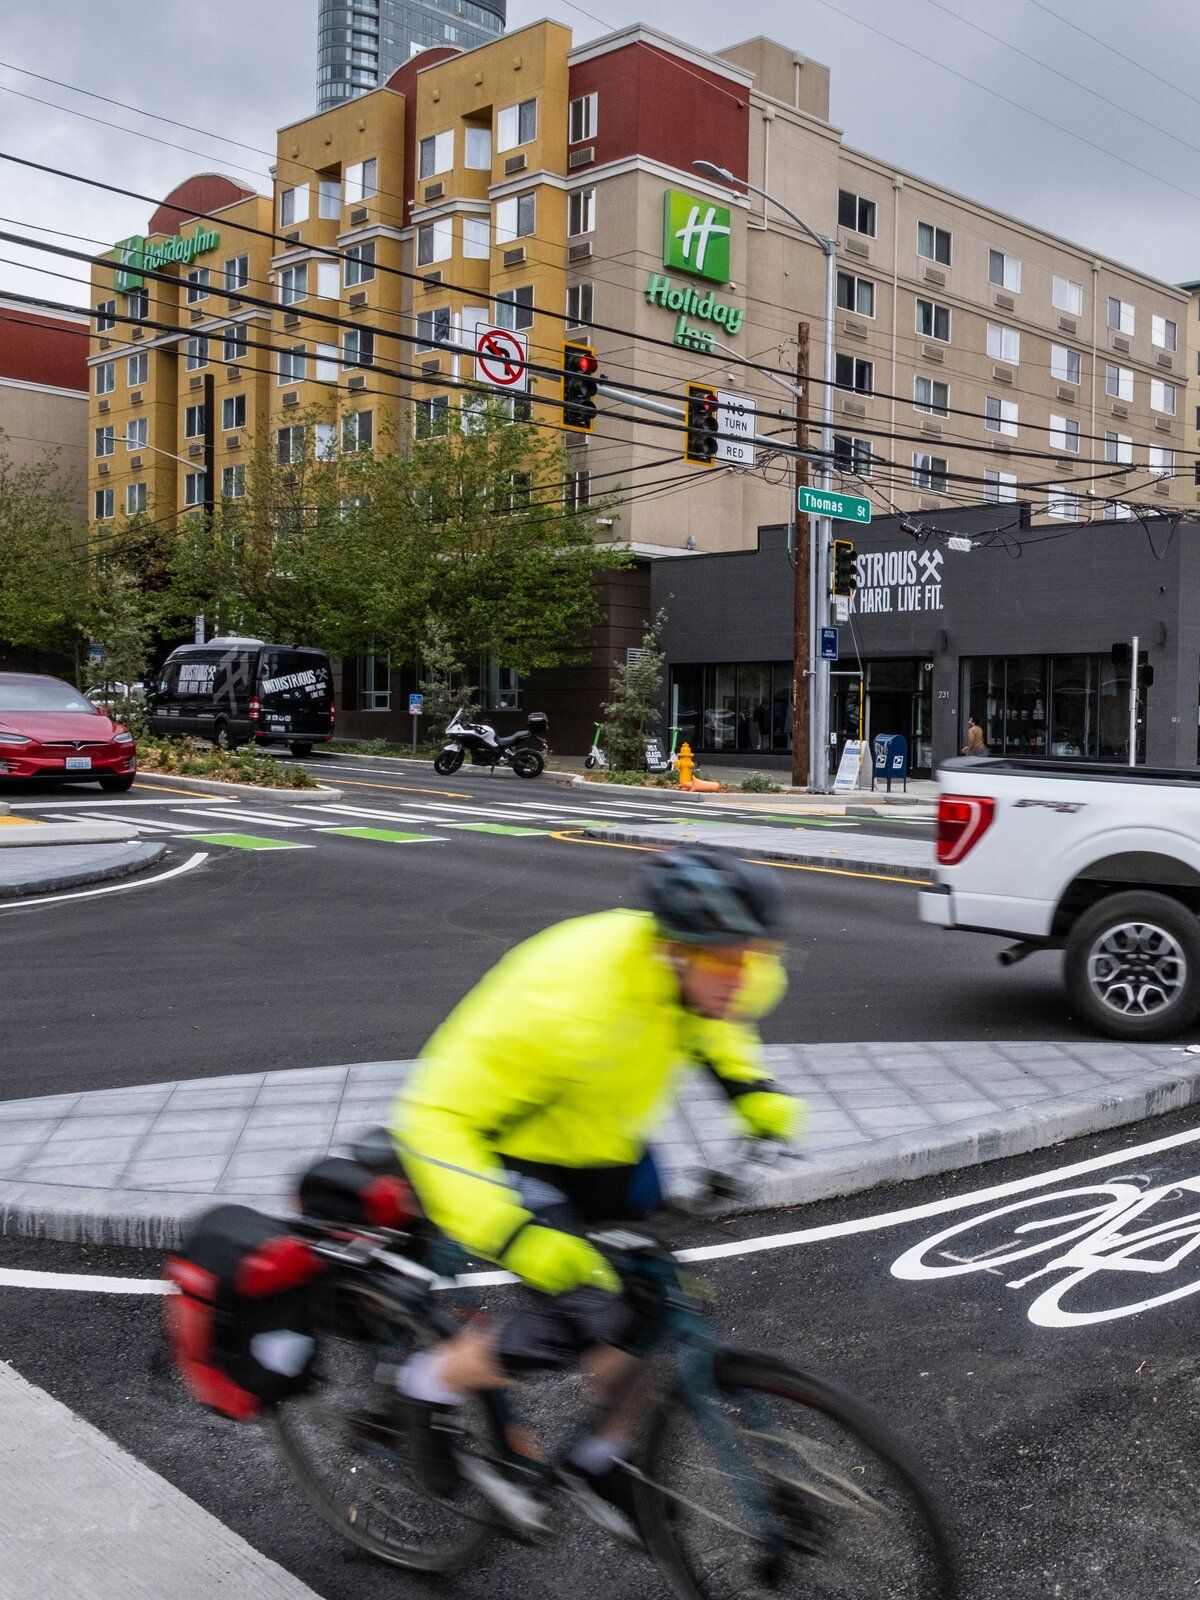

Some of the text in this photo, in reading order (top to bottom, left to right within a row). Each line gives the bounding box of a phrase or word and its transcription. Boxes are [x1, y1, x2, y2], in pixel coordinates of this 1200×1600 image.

[144, 225, 219, 269] Holiday Inn
[646, 273, 744, 335] Holiday
[674, 314, 716, 353] Inn
[724, 417, 748, 432] TURN
[726, 445, 744, 459] RED
[804, 492, 866, 517] Thomas St
[860, 587, 893, 614] HARD.
[897, 585, 921, 612] LIVE
[262, 670, 316, 694] INDUSTRIOUS
[939, 691, 949, 699] 231
